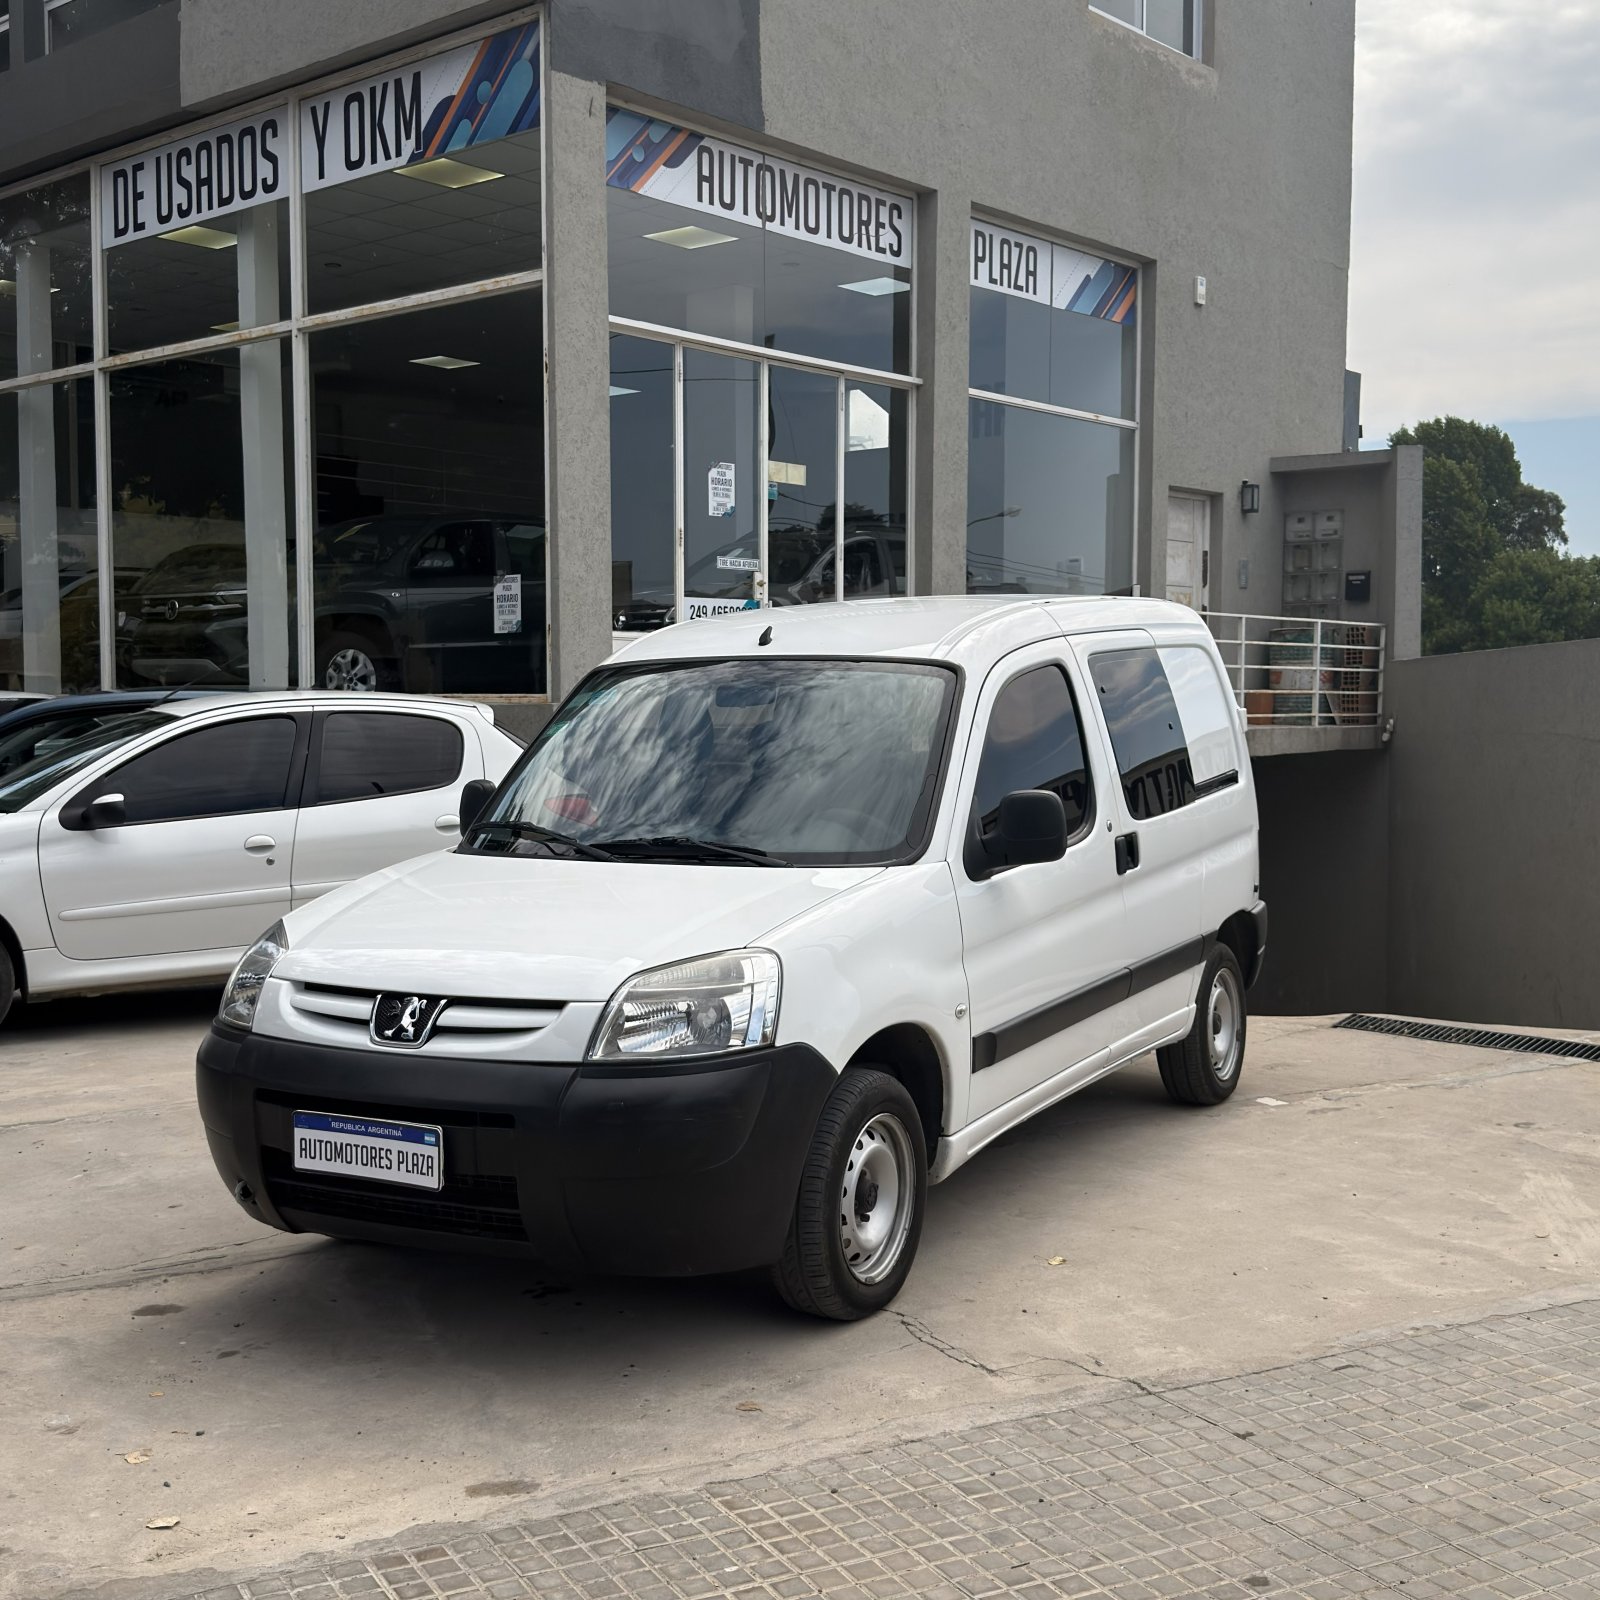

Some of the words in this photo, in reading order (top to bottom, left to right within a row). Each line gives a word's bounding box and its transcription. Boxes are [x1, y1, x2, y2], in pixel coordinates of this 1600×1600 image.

[113, 161, 146, 238] DE
[155, 118, 279, 225] USADOS
[310, 100, 331, 180] Y
[696, 145, 903, 258] AUTOMOTORES
[973, 229, 1037, 296] PLAZA
[711, 477, 733, 487] HORARIO
[719, 558, 729, 567] TIRE
[729, 559, 742, 568] HACIA
[742, 560, 758, 569] AFUERA
[496, 594, 519, 603] HORARIO
[689, 604, 708, 620] 249
[331, 1121, 366, 1132] REPUBLICA
[367, 1126, 403, 1137] ARGENTINA
[299, 1137, 393, 1170] AUTOMOTORES
[397, 1149, 434, 1178] PLAZA
